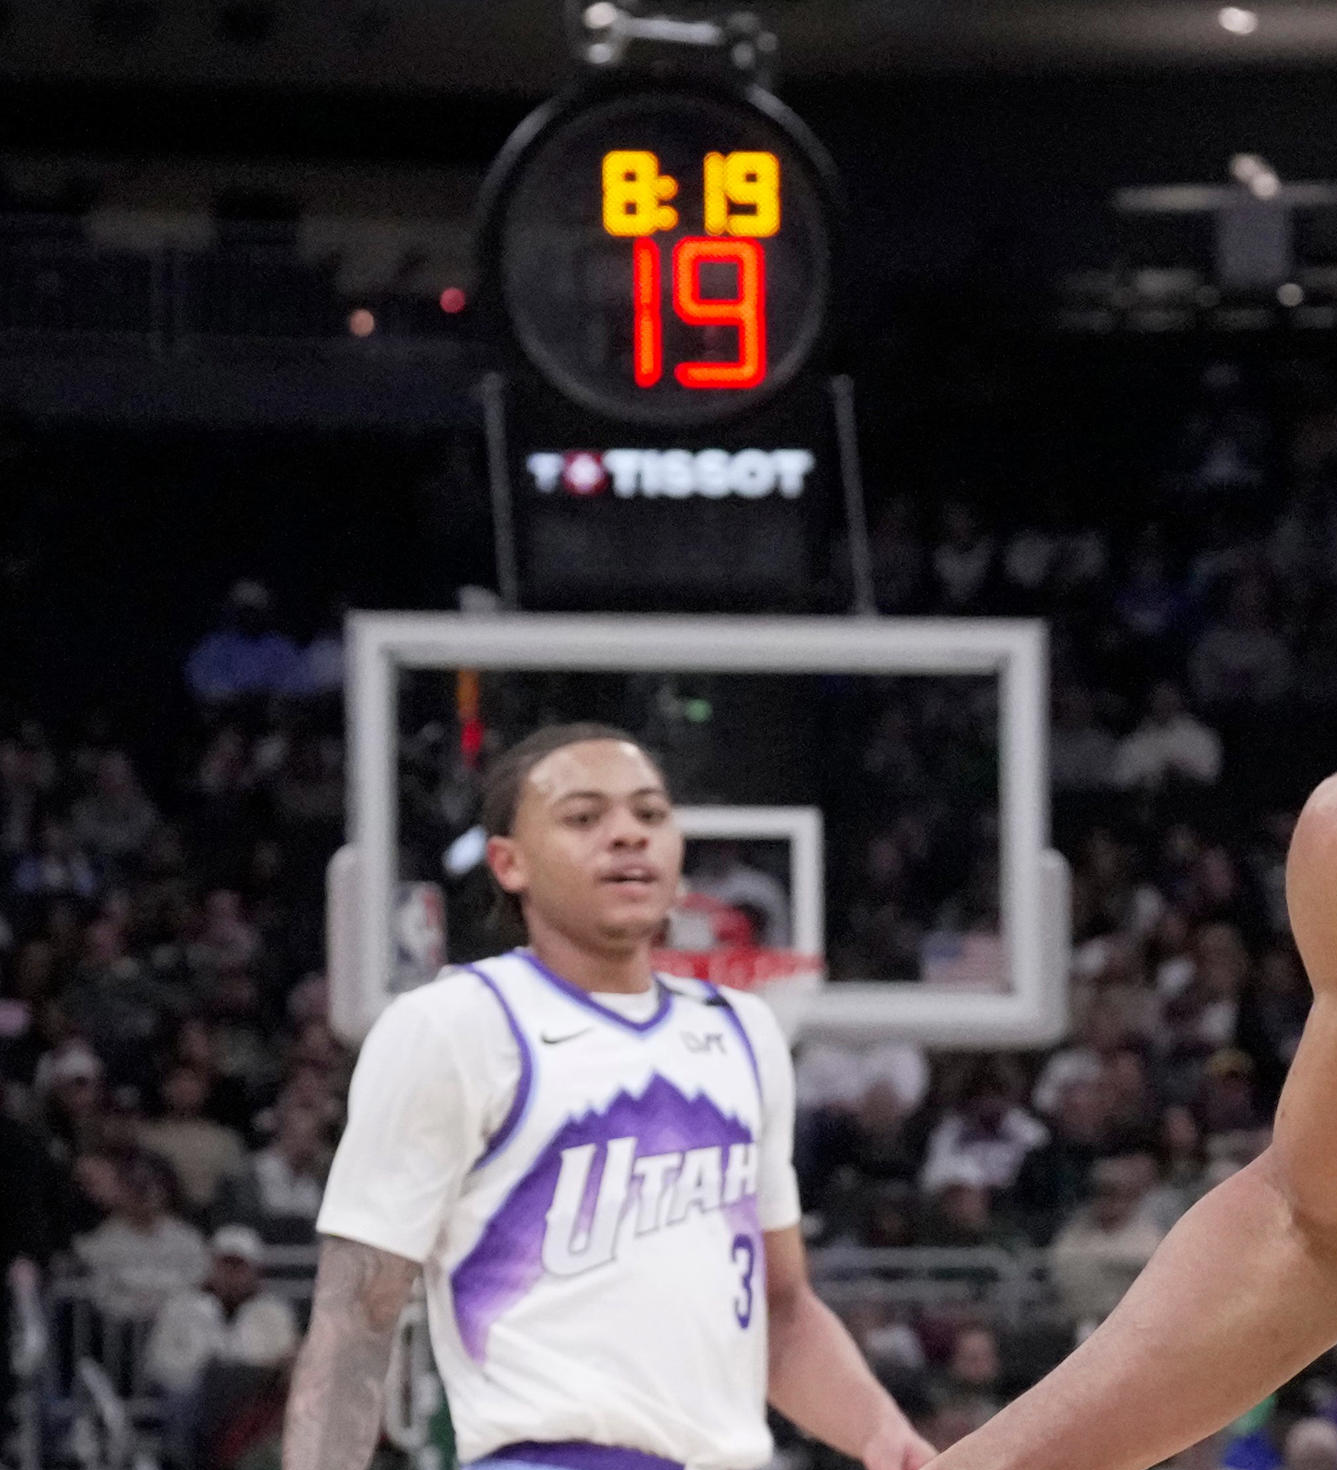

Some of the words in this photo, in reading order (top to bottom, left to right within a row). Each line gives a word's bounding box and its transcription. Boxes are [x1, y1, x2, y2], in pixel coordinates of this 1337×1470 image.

[602, 150, 781, 236] 8:19
[633, 236, 766, 388] 19
[604, 448, 814, 498] TISSOT
[731, 1233, 754, 1330] 3
